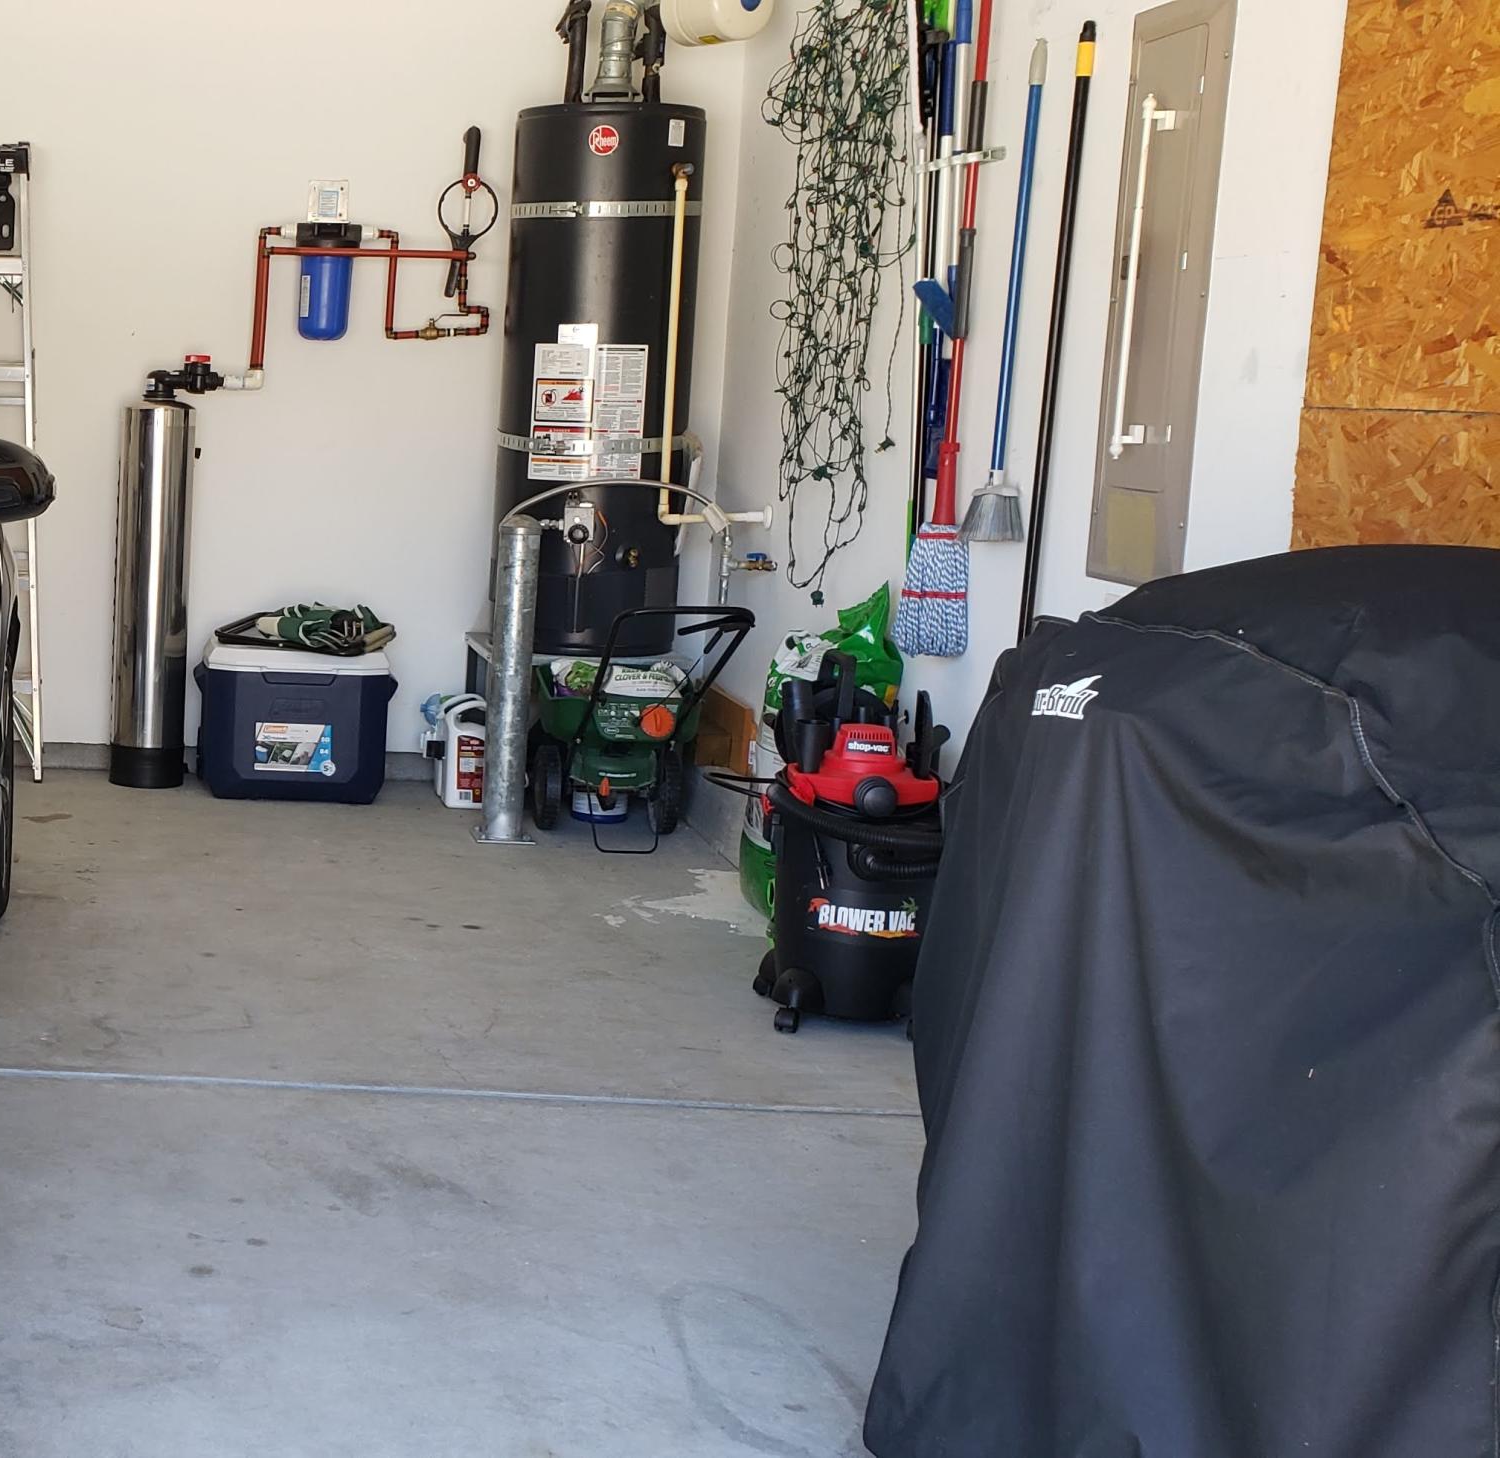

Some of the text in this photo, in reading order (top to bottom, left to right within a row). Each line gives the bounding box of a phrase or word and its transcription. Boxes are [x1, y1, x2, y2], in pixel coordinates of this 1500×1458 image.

[592, 127, 618, 151] Rheem
[848, 741, 889, 753] shop-vac
[819, 904, 916, 932] BLOWER VAC
